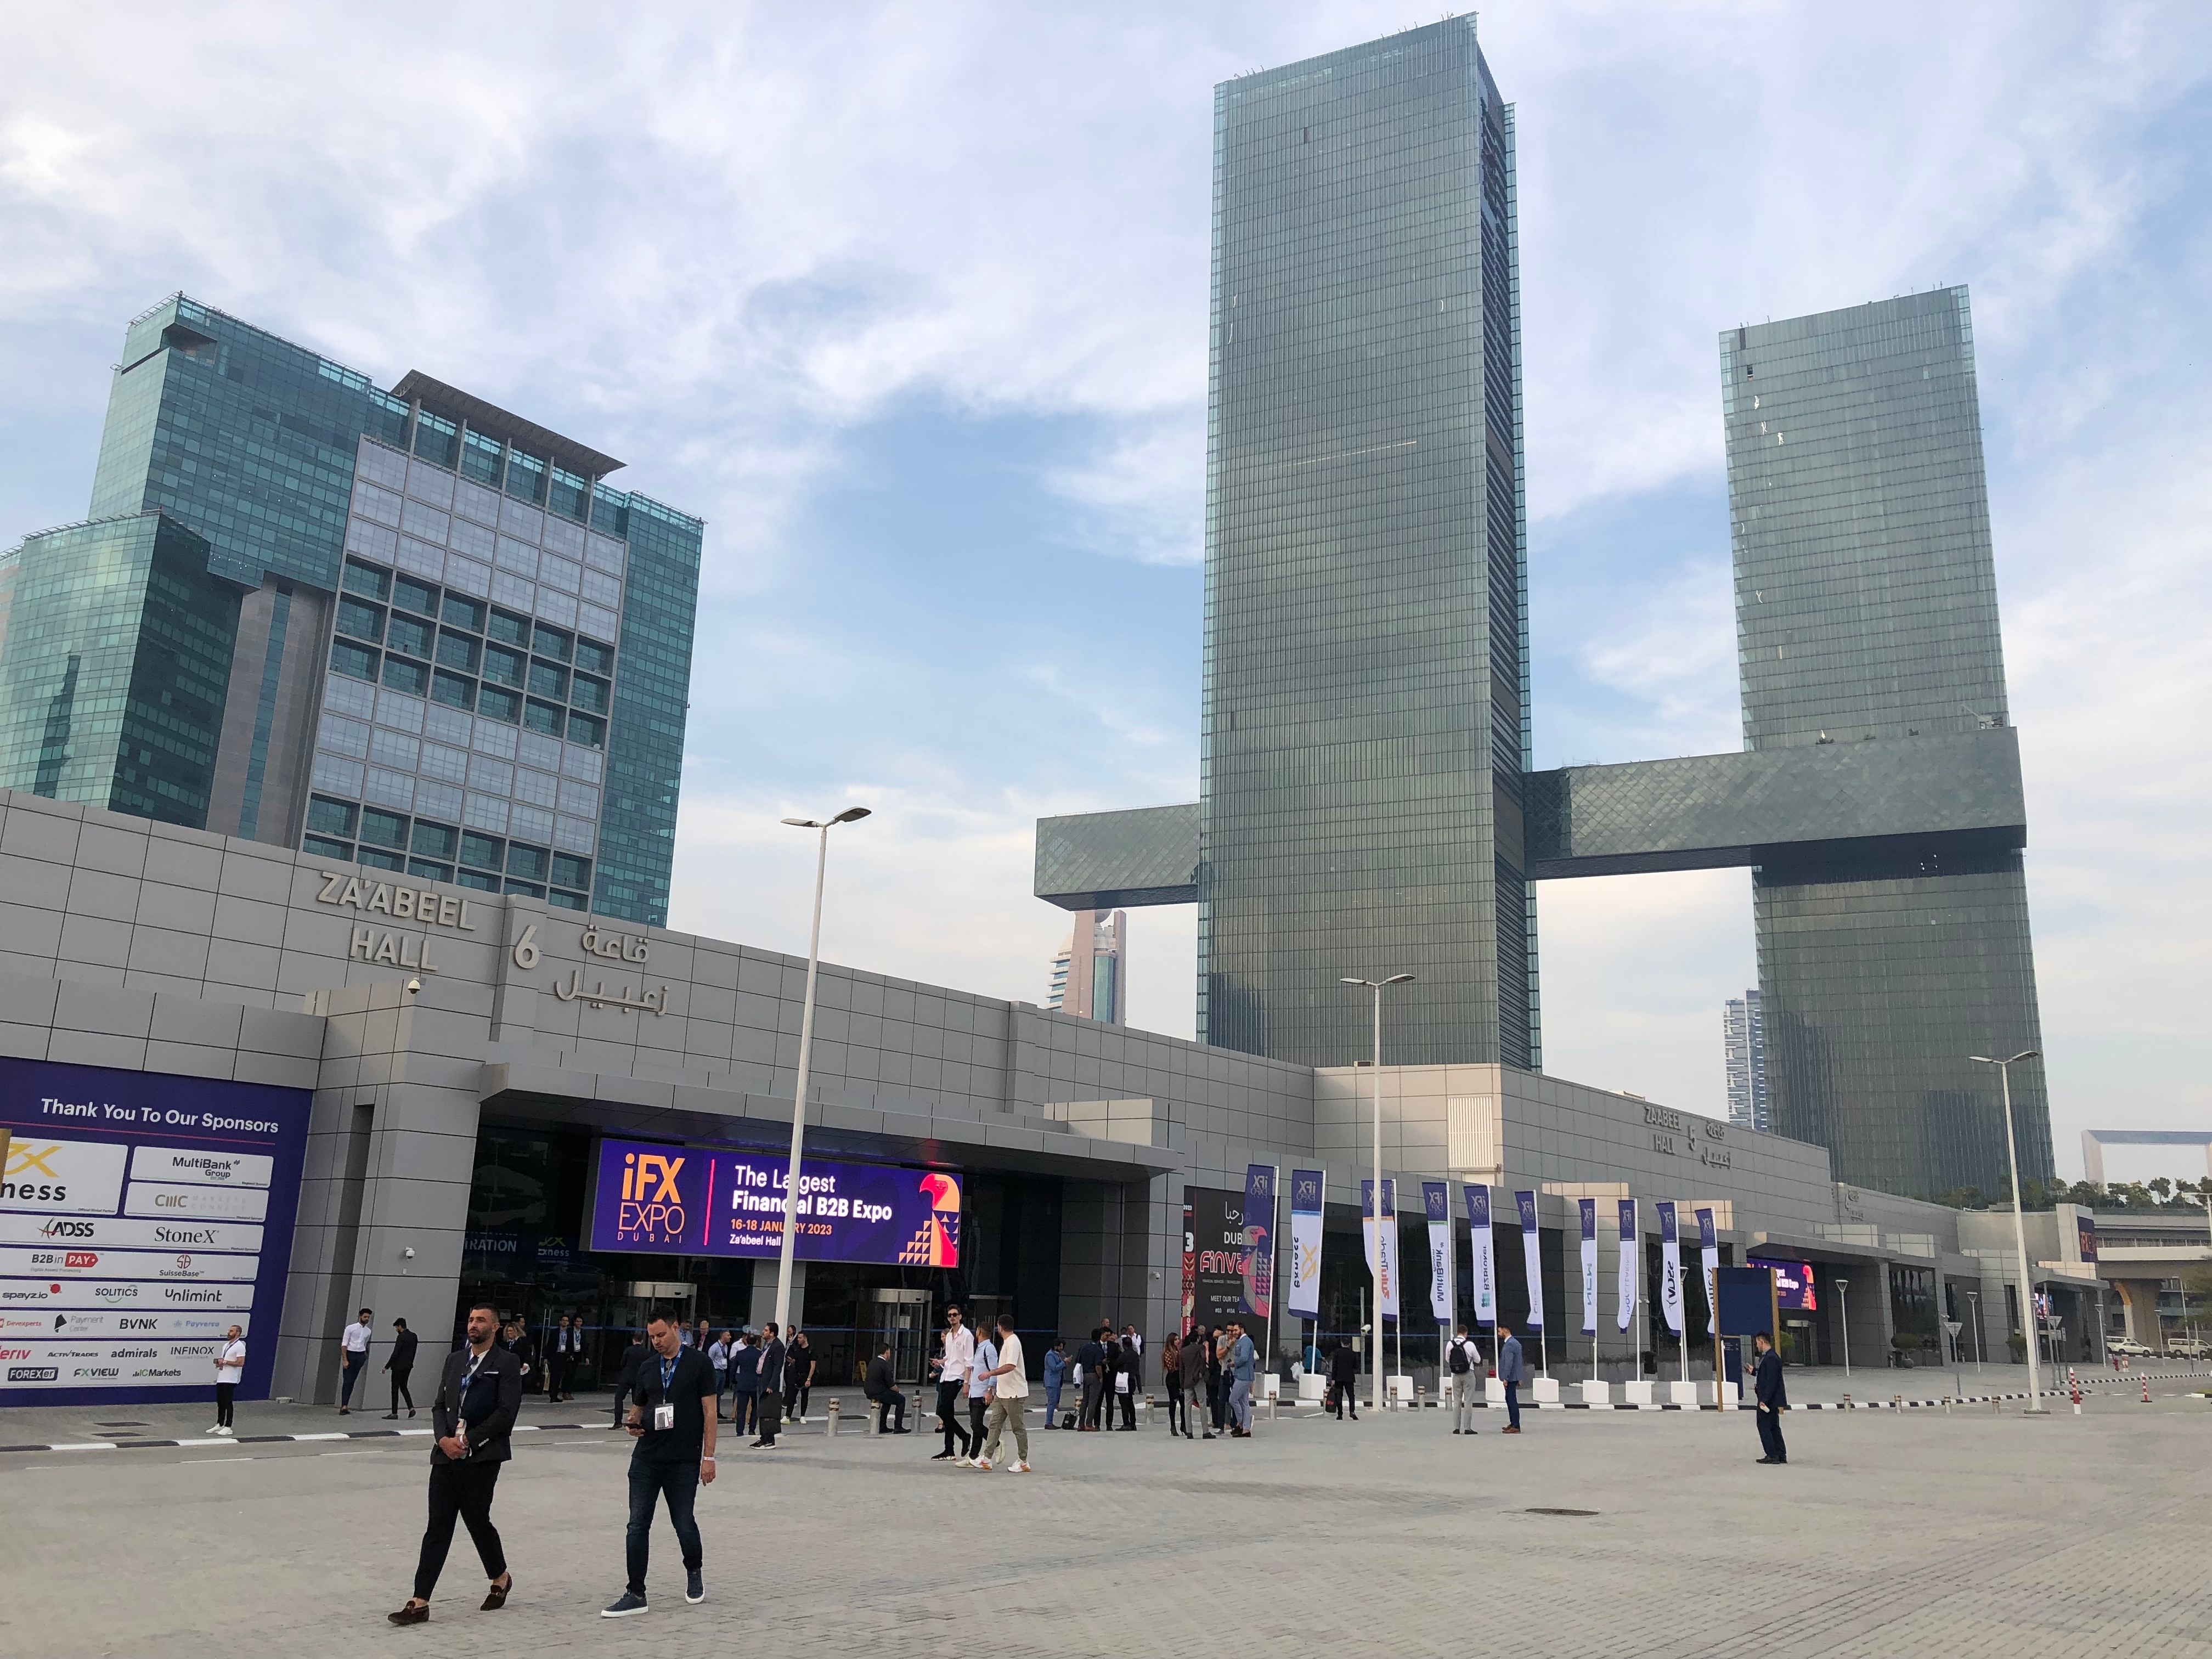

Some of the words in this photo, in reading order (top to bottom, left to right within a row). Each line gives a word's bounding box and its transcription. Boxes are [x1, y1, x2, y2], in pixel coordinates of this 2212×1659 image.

[349, 927, 438, 971] HALL
[515, 924, 540, 969] 6
[582, 924, 649, 963] قاعة
[555, 969, 669, 1015] زعبيل
[41, 1098, 97, 1118] Thank
[103, 1104, 136, 1121] You
[141, 1107, 161, 1123] To
[165, 1109, 199, 1126] Our
[202, 1113, 279, 1133] Sponsors
[172, 1156, 232, 1170] MultiBank
[205, 1169, 230, 1179] Group
[622, 1153, 685, 1204] iFX
[735, 1165, 767, 1187] The
[773, 1169, 836, 1194] Lagest
[0, 1182, 66, 1201] ness
[732, 1190, 811, 1215] Financal
[816, 1197, 848, 1217] B2B
[853, 1200, 892, 1223] Expo
[1225, 1201, 1244, 1226] رحبا
[619, 1202, 685, 1234] EXPO
[730, 1218, 757, 1231] 16-18
[759, 1220, 806, 1234] JANURY
[808, 1223, 832, 1235] 2023
[51, 1221, 94, 1238] ADSS
[154, 1226, 217, 1244] StoneX
[617, 1231, 681, 1244] DUBAI
[765, 1235, 781, 1246] Hall
[1185, 1232, 1194, 1252] 3
[1224, 1232, 1243, 1245] DUB
[95, 1288, 138, 1297] SOLITICS
[165, 1289, 222, 1302] Unlimint
[71, 1316, 104, 1325] Payment
[119, 1318, 158, 1330] BVNK
[0, 1345, 31, 1360] eriv
[111, 1347, 157, 1358] admirals
[171, 1346, 215, 1355] INFINOX
